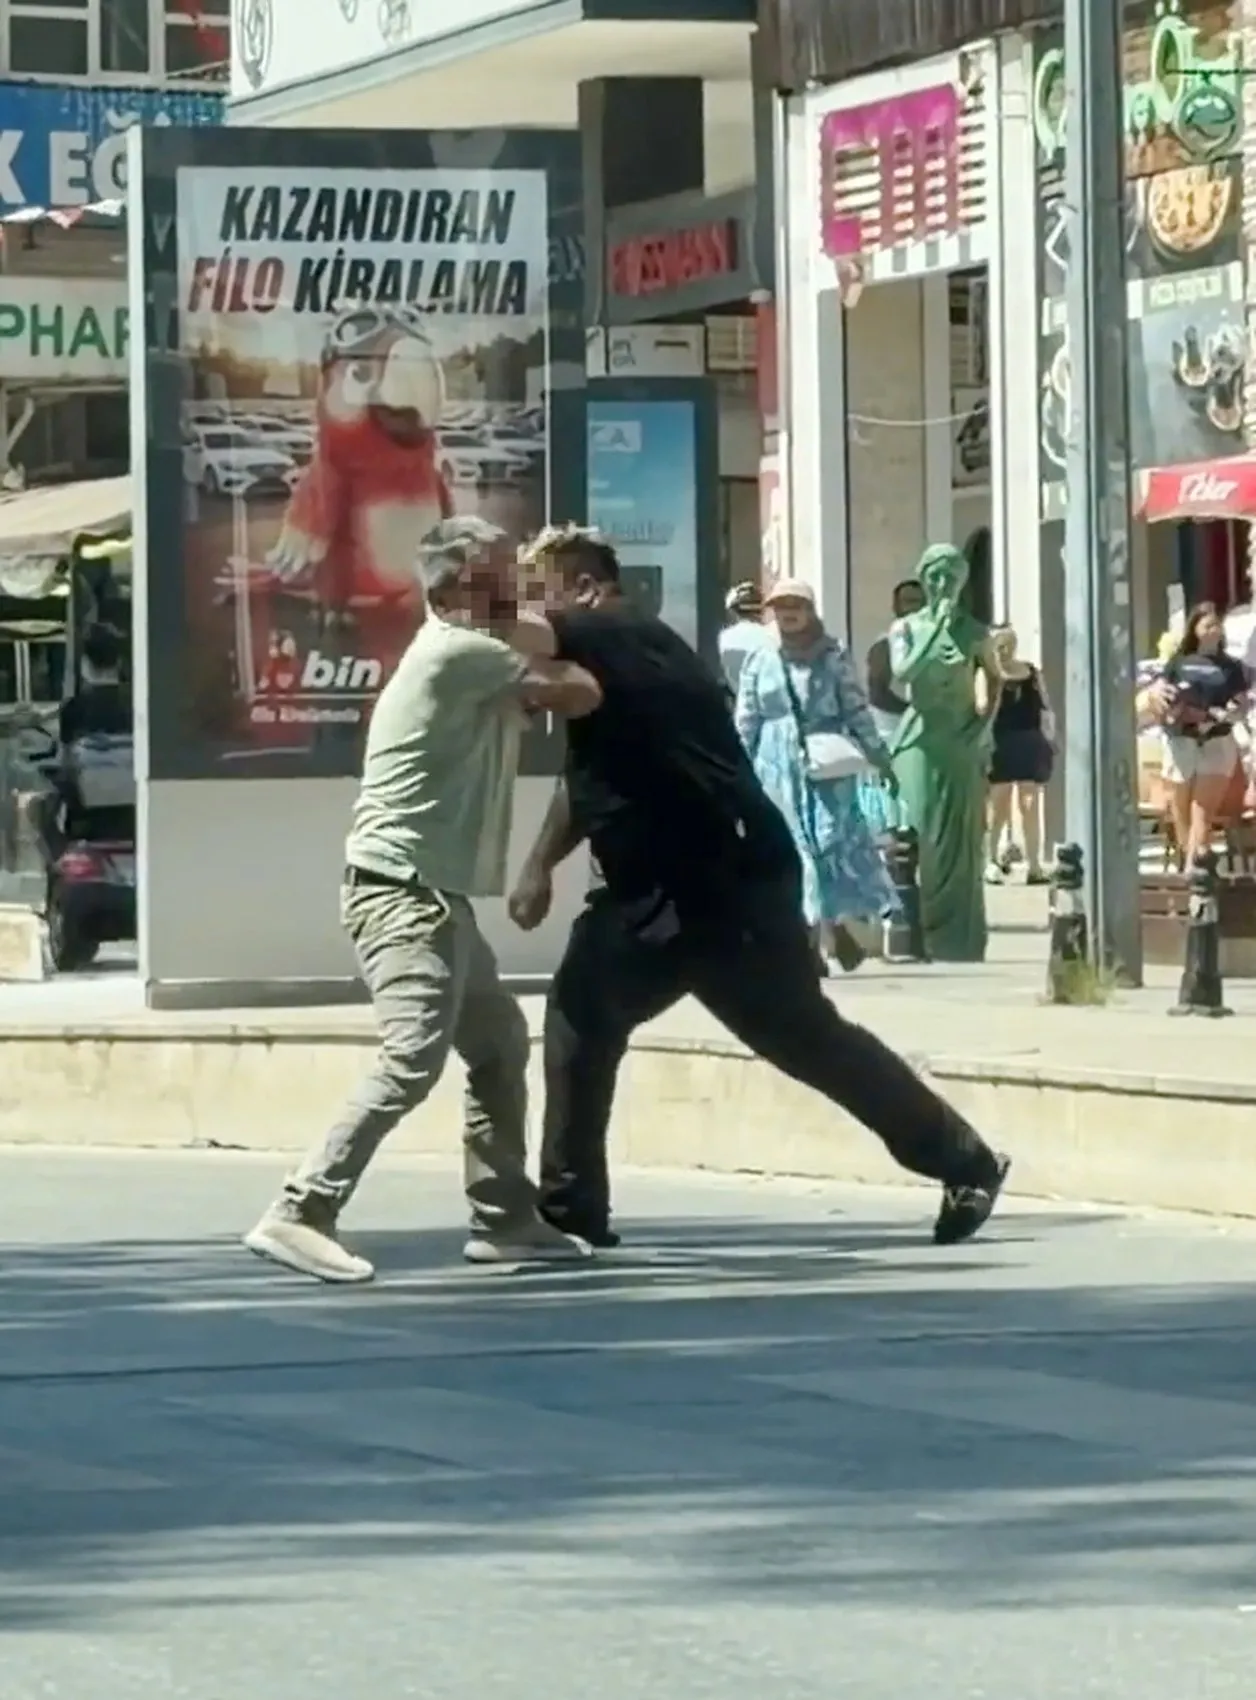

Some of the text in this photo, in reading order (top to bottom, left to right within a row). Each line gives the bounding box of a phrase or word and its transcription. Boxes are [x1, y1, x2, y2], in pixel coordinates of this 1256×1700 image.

[219, 185, 516, 244] KAZANDIRAN
[187, 246, 285, 313] FİLO
[292, 248, 528, 314] KİRALAMA
[301, 649, 382, 688] bin
